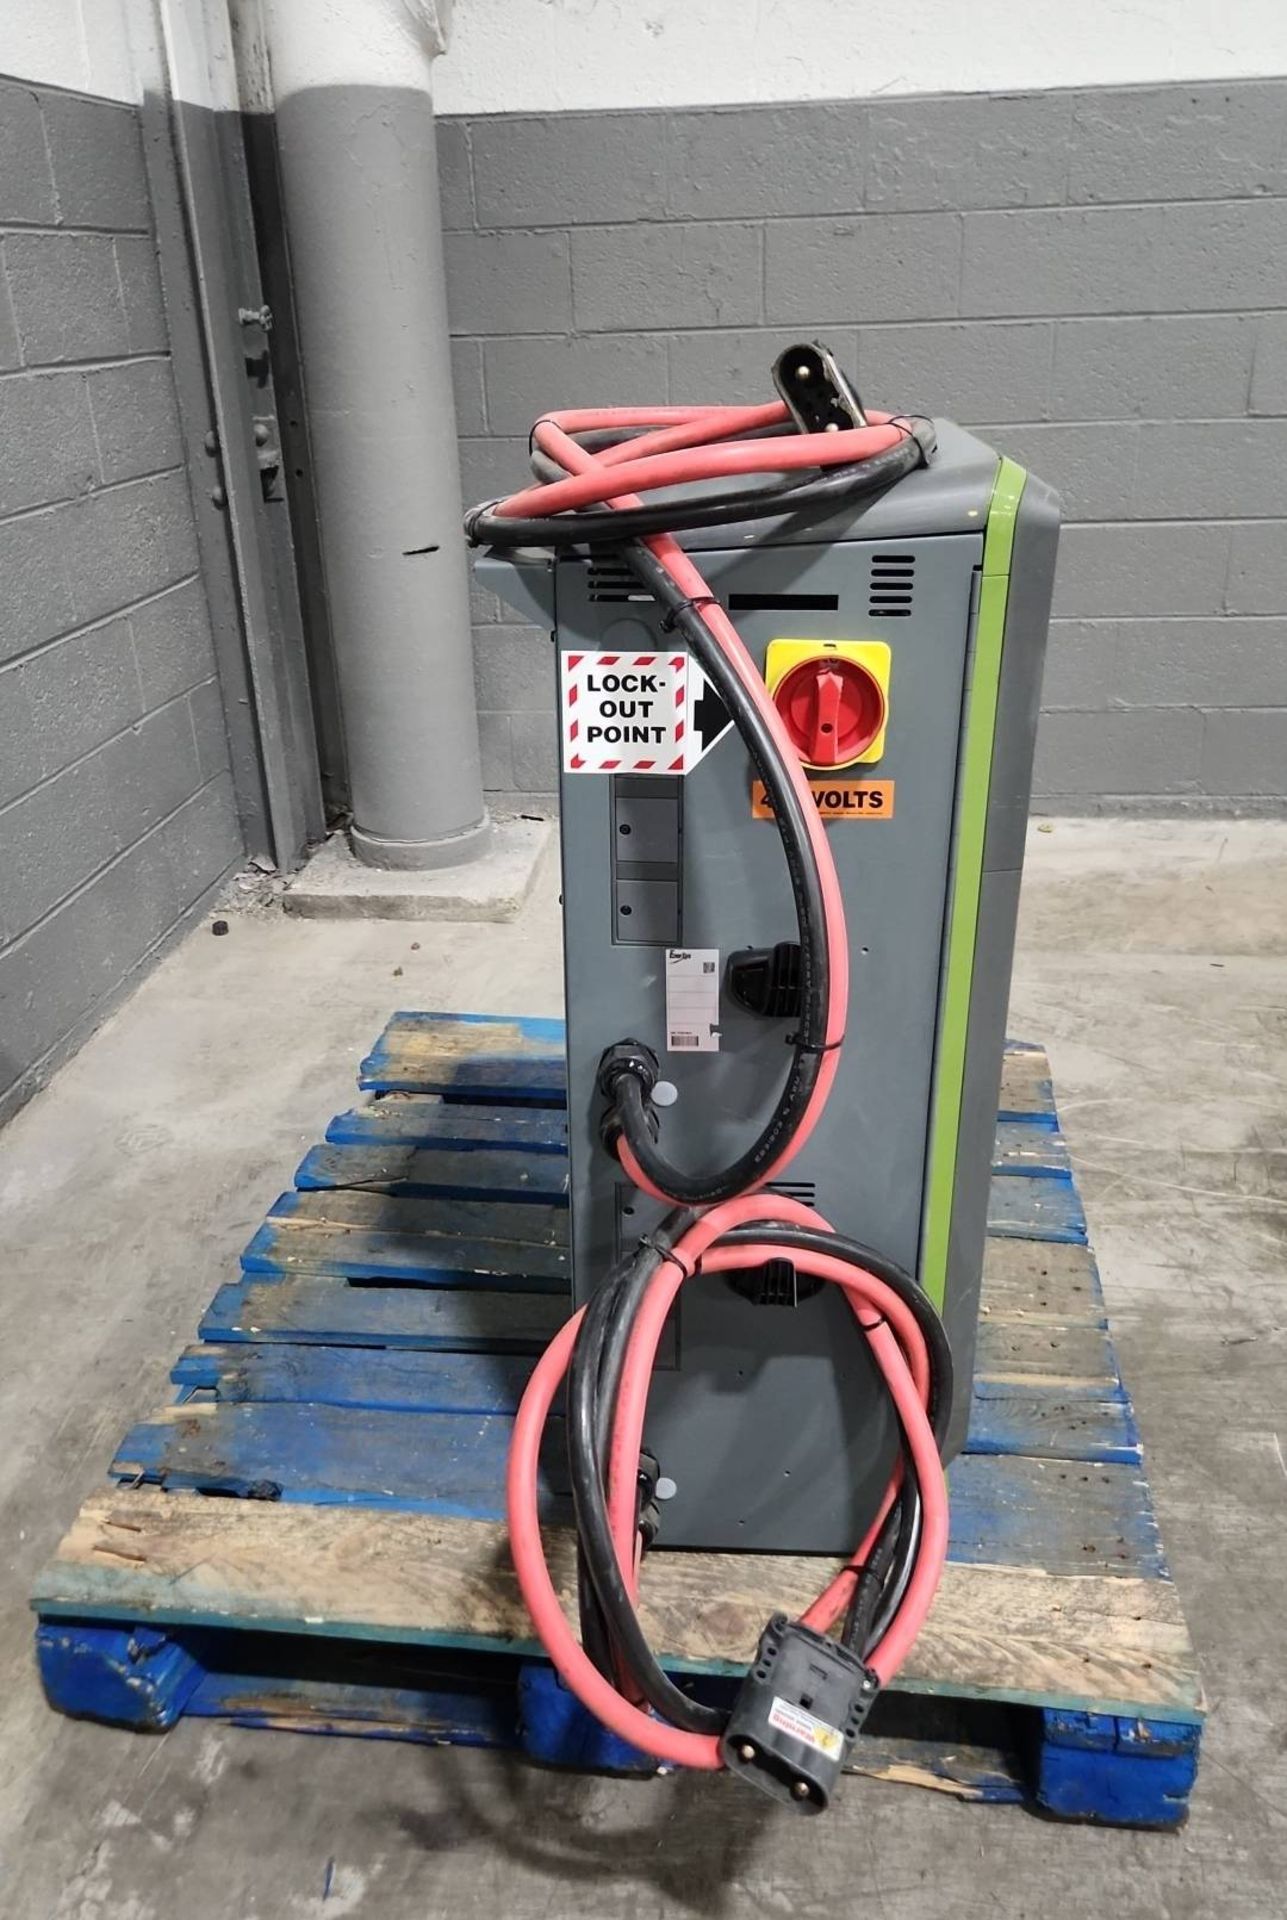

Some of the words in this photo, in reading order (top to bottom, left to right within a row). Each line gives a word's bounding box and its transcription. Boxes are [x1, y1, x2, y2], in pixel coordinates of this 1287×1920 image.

[587, 674, 666, 693] LOCK-
[599, 700, 654, 718] OUT
[587, 726, 666, 744] POINT
[811, 790, 883, 808] VOLTS
